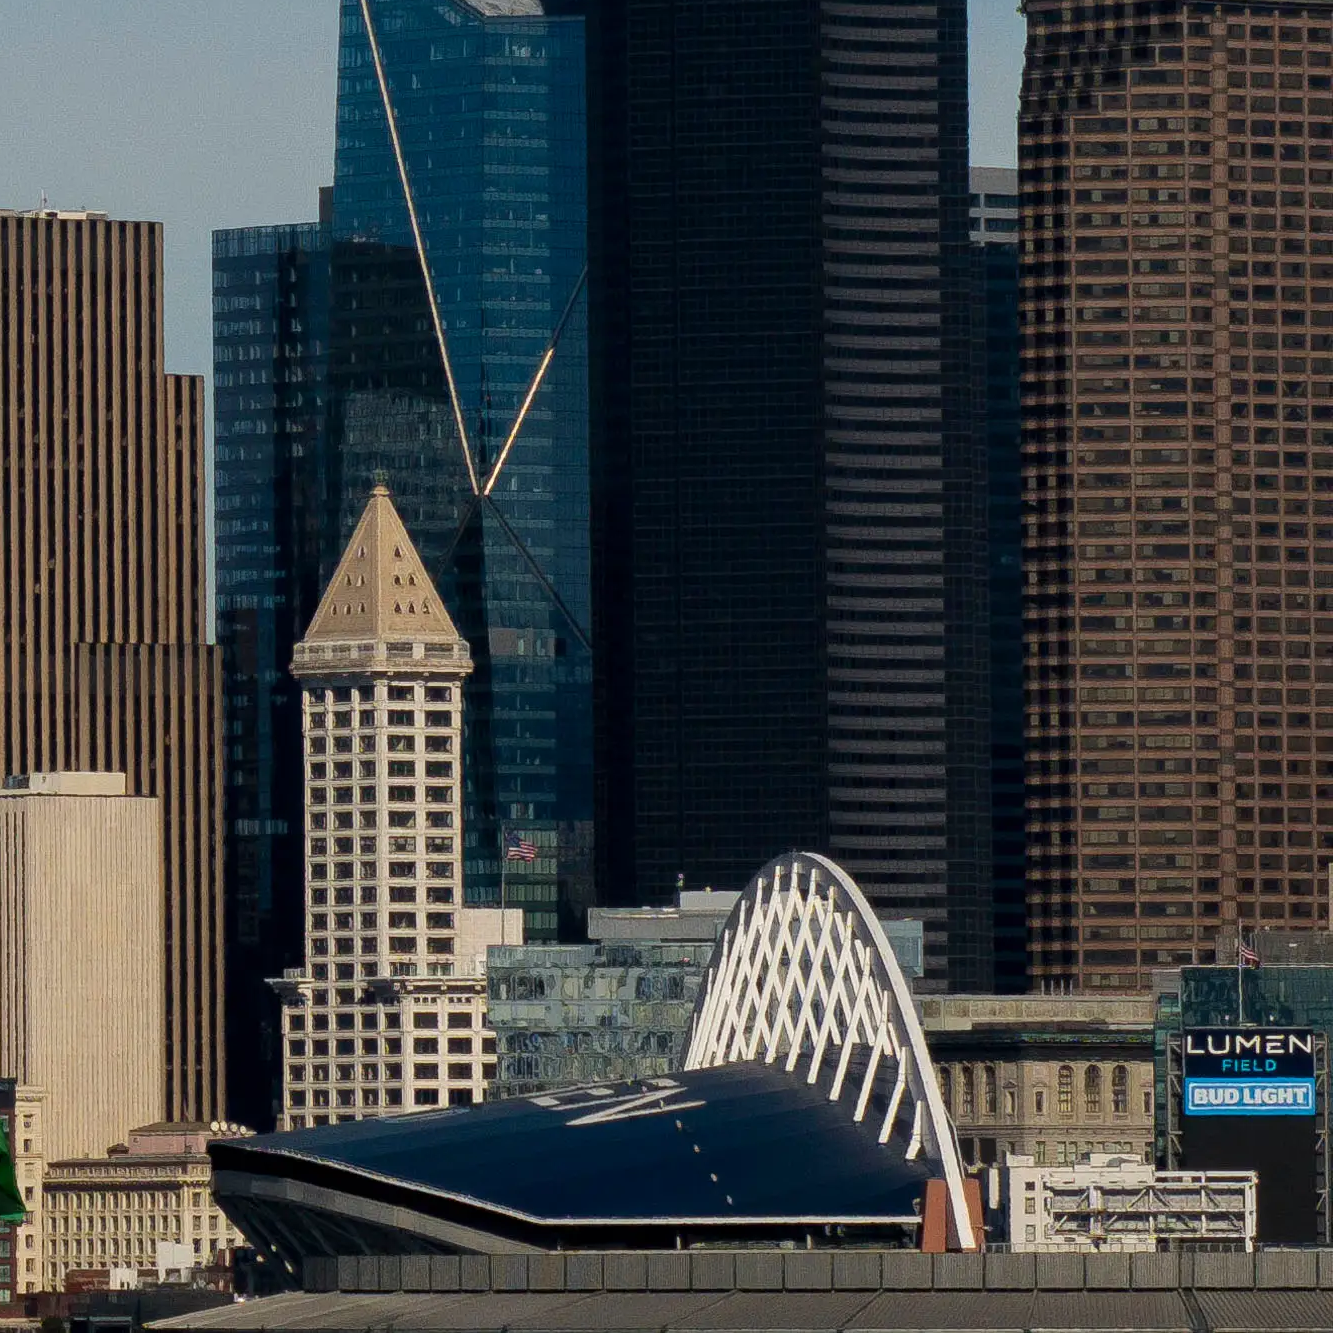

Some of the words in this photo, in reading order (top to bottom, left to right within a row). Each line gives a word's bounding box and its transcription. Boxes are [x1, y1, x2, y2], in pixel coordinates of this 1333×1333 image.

[1186, 1034, 1313, 1055] LUMEN
[1222, 1059, 1277, 1072] FIELD
[1193, 1087, 1240, 1105] BUD
[1242, 1087, 1308, 1105] LIGHT
